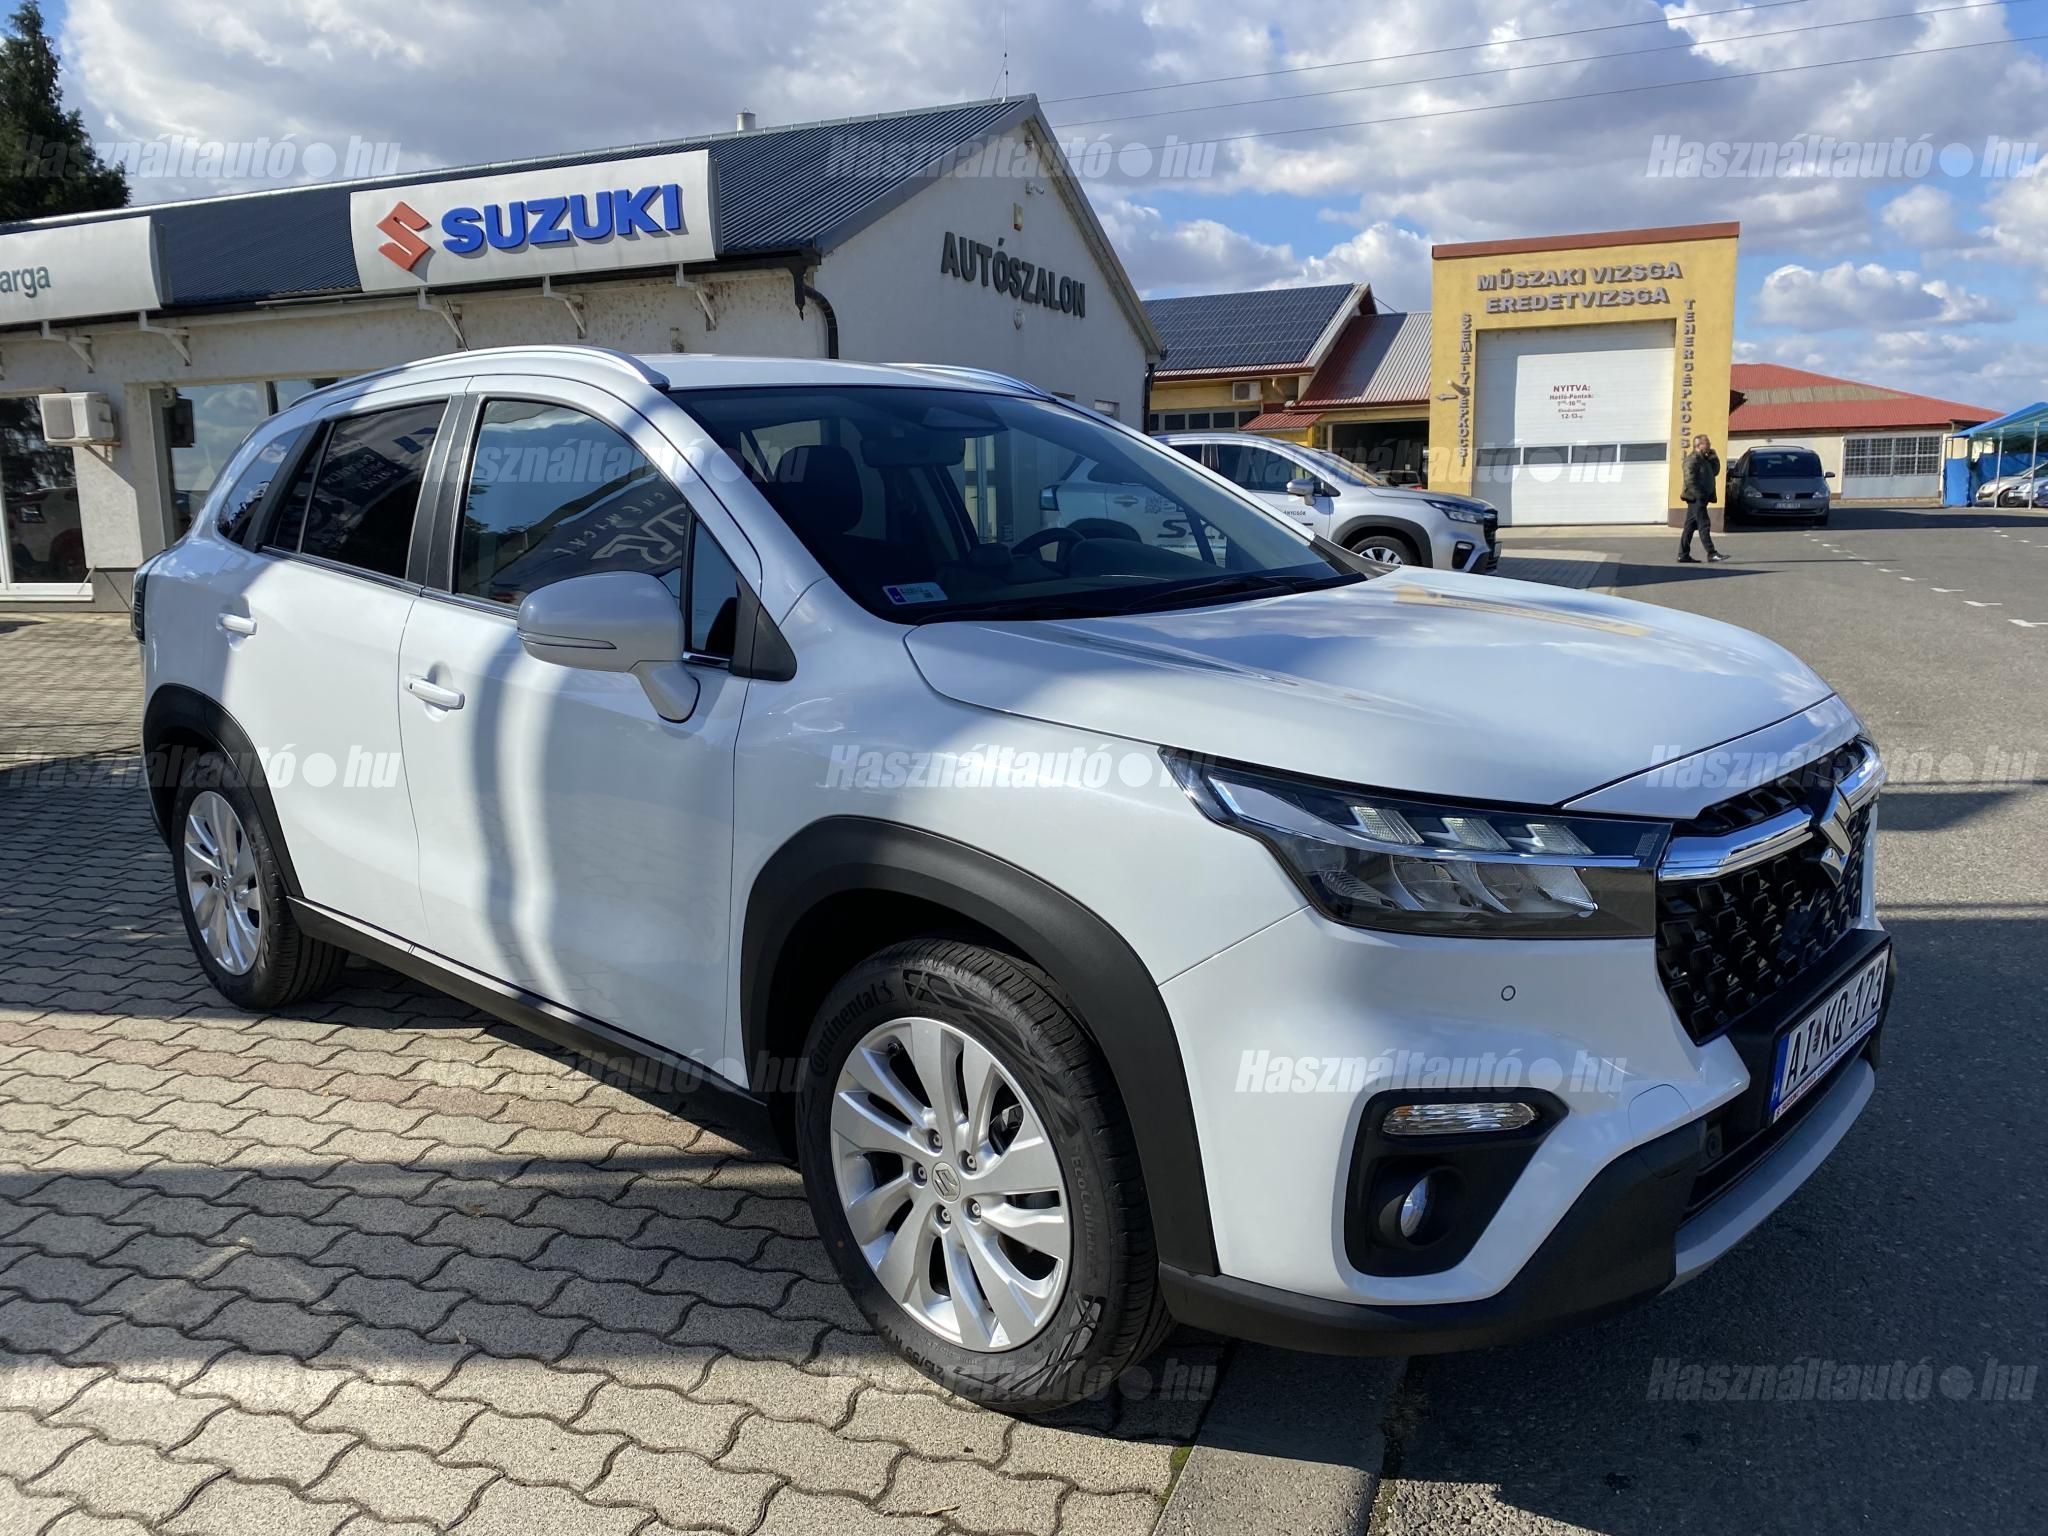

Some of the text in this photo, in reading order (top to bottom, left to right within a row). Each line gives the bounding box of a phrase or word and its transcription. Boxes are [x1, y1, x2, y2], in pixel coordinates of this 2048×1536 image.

[441, 183, 682, 254] SUZUKI
[0, 266, 51, 298] arga
[941, 231, 1086, 318] AUTÓSZALON
[1477, 262, 1683, 291] MŰSZAKI VIZSGA
[1486, 287, 1671, 314] EREDETVIZSGA
[1553, 384, 1591, 392] NYITVA:
[1785, 1018, 1816, 1091] AI
